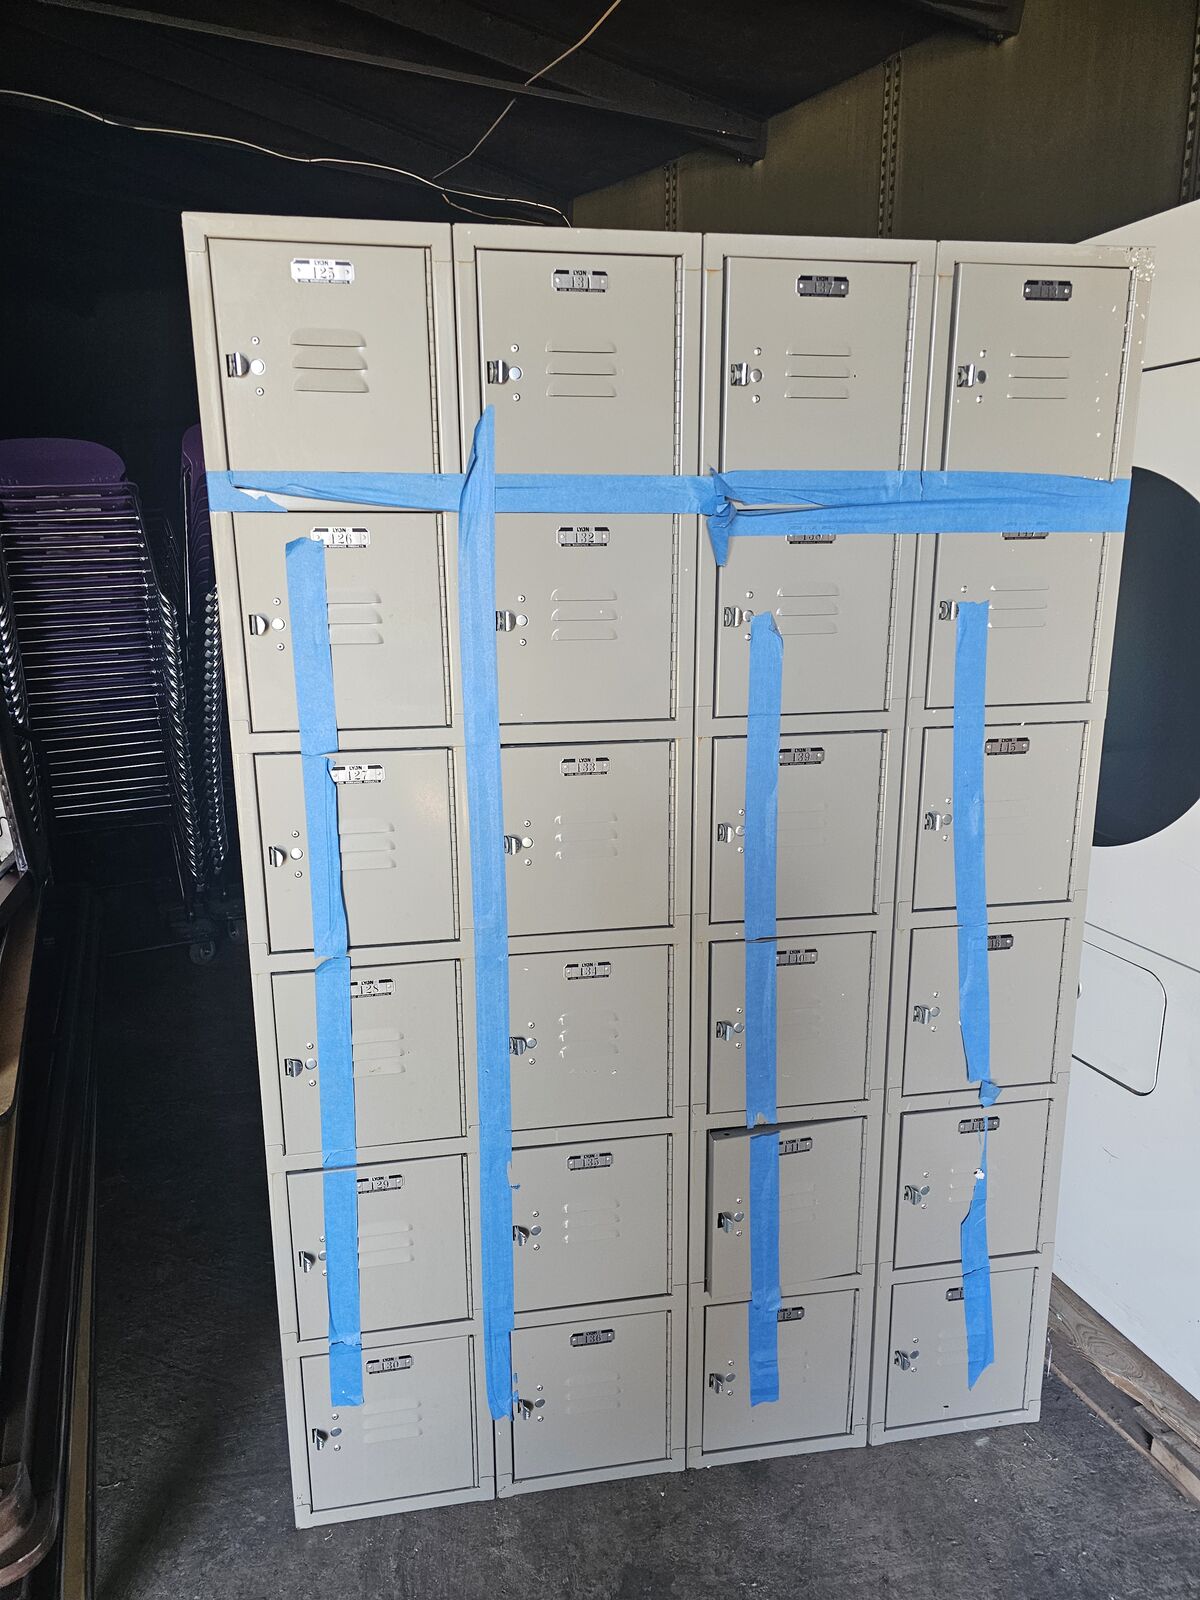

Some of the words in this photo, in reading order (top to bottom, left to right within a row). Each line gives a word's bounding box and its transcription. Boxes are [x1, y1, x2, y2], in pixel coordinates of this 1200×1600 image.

[313, 266, 335, 279] 125
[572, 276, 590, 288] 131
[331, 533, 352, 544] 126
[575, 532, 595, 543] 132
[793, 752, 810, 762] 139
[577, 762, 596, 772] 133
[348, 770, 367, 780] 127
[360, 985, 379, 995] 128
[582, 1157, 600, 1167] 135
[371, 1180, 389, 1191] 129
[585, 1334, 602, 1344] 136
[381, 1360, 399, 1370] 130
